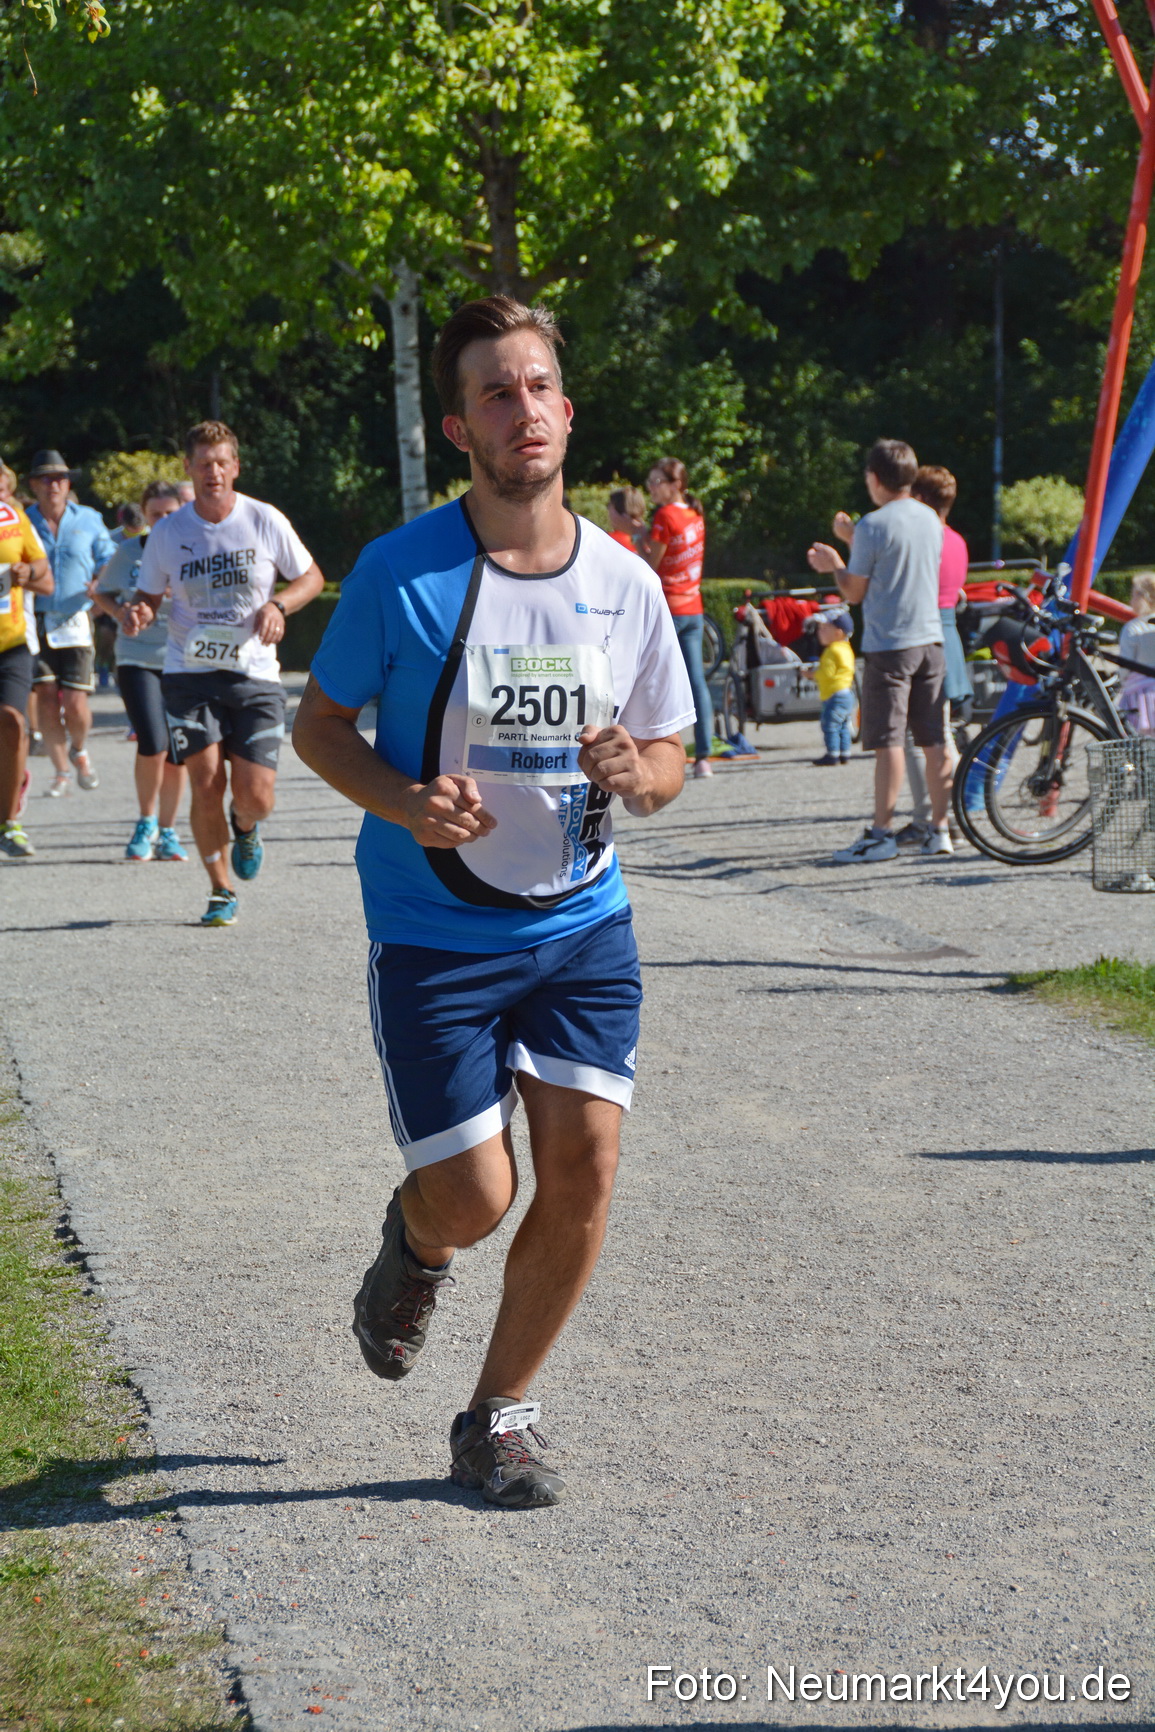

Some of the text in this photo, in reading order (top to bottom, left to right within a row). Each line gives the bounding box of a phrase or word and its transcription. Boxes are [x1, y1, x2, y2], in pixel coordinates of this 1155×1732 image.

[180, 548, 256, 581] FINISHER
[211, 569, 249, 588] 2018
[194, 640, 240, 661] 2574
[511, 658, 572, 672] BOCK
[490, 684, 586, 727] 2501
[476, 717, 482, 725] C
[498, 733, 571, 741] PARTL Neumarkt
[511, 752, 567, 769] Robert
[579, 782, 613, 876] BER
